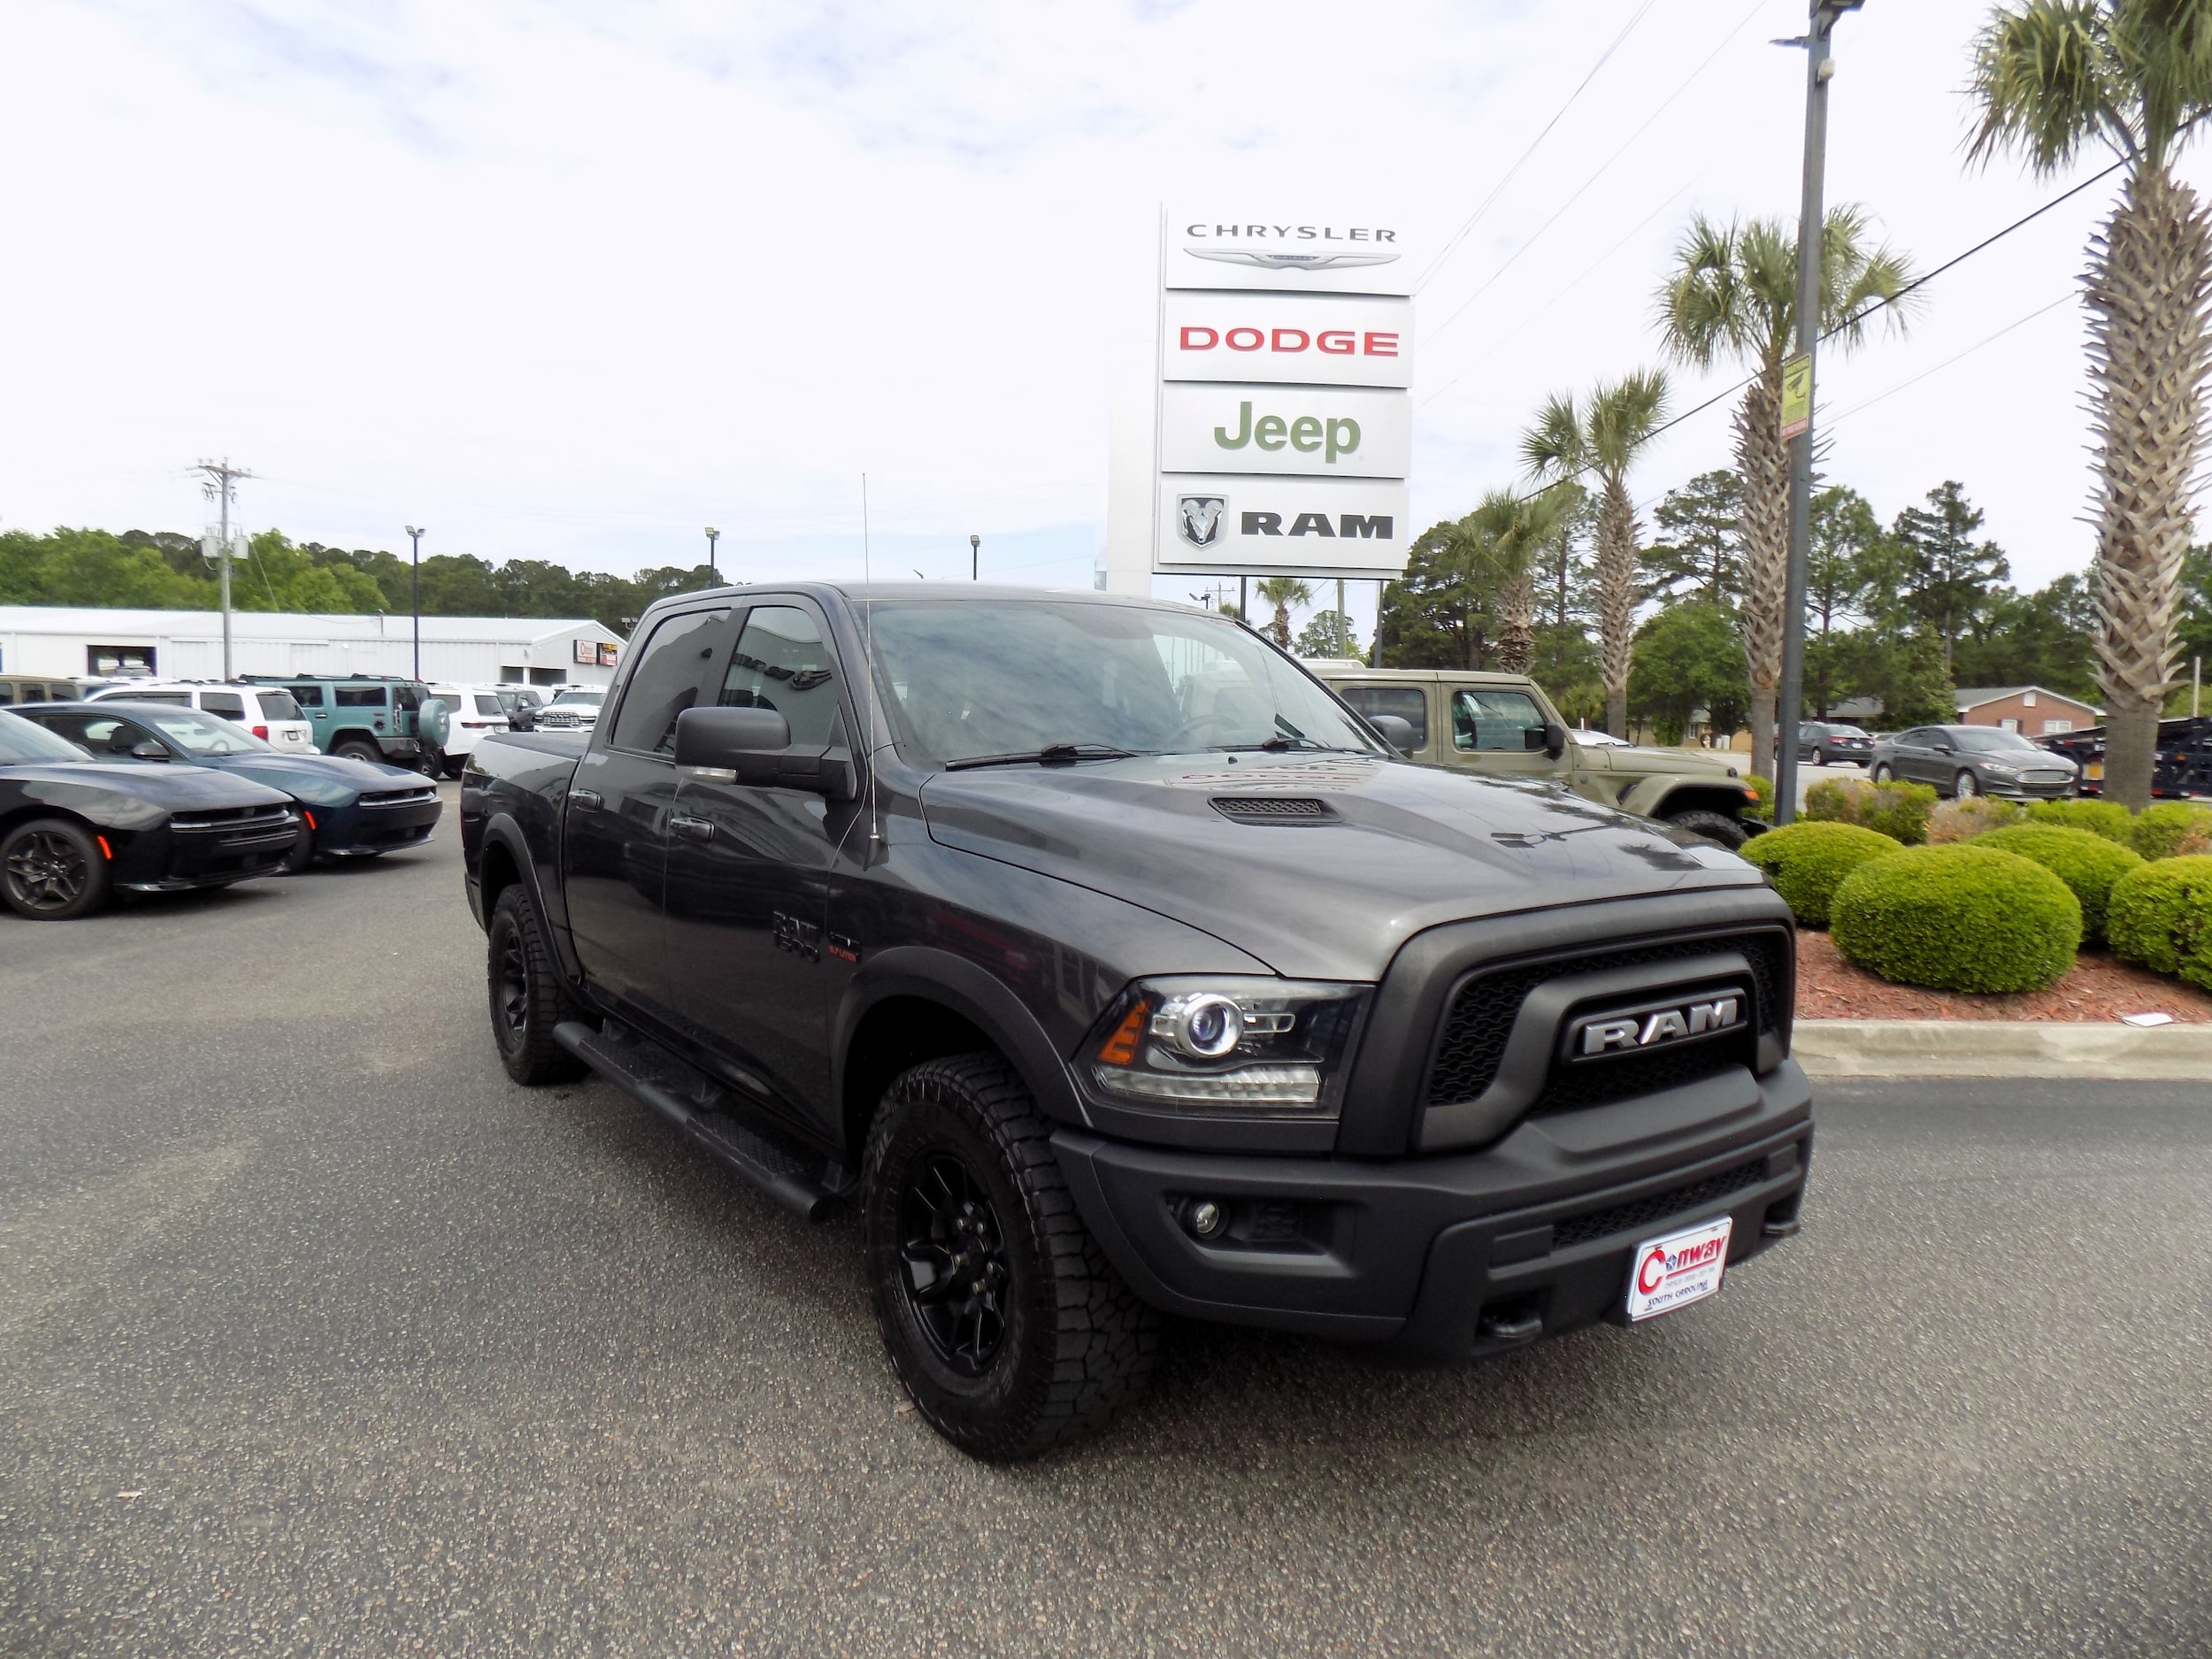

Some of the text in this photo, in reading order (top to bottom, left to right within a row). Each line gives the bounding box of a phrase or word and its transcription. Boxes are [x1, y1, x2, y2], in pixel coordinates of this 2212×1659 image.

[1187, 224, 1397, 243] CHRYSLER
[1180, 326, 1400, 357] DODGE
[1214, 401, 1361, 464] Jeep
[1240, 511, 1394, 540] RAM
[1584, 997, 1738, 1056] RAM
[1638, 1235, 1727, 1295] Conway
[1647, 1293, 1673, 1307] SOUTH
